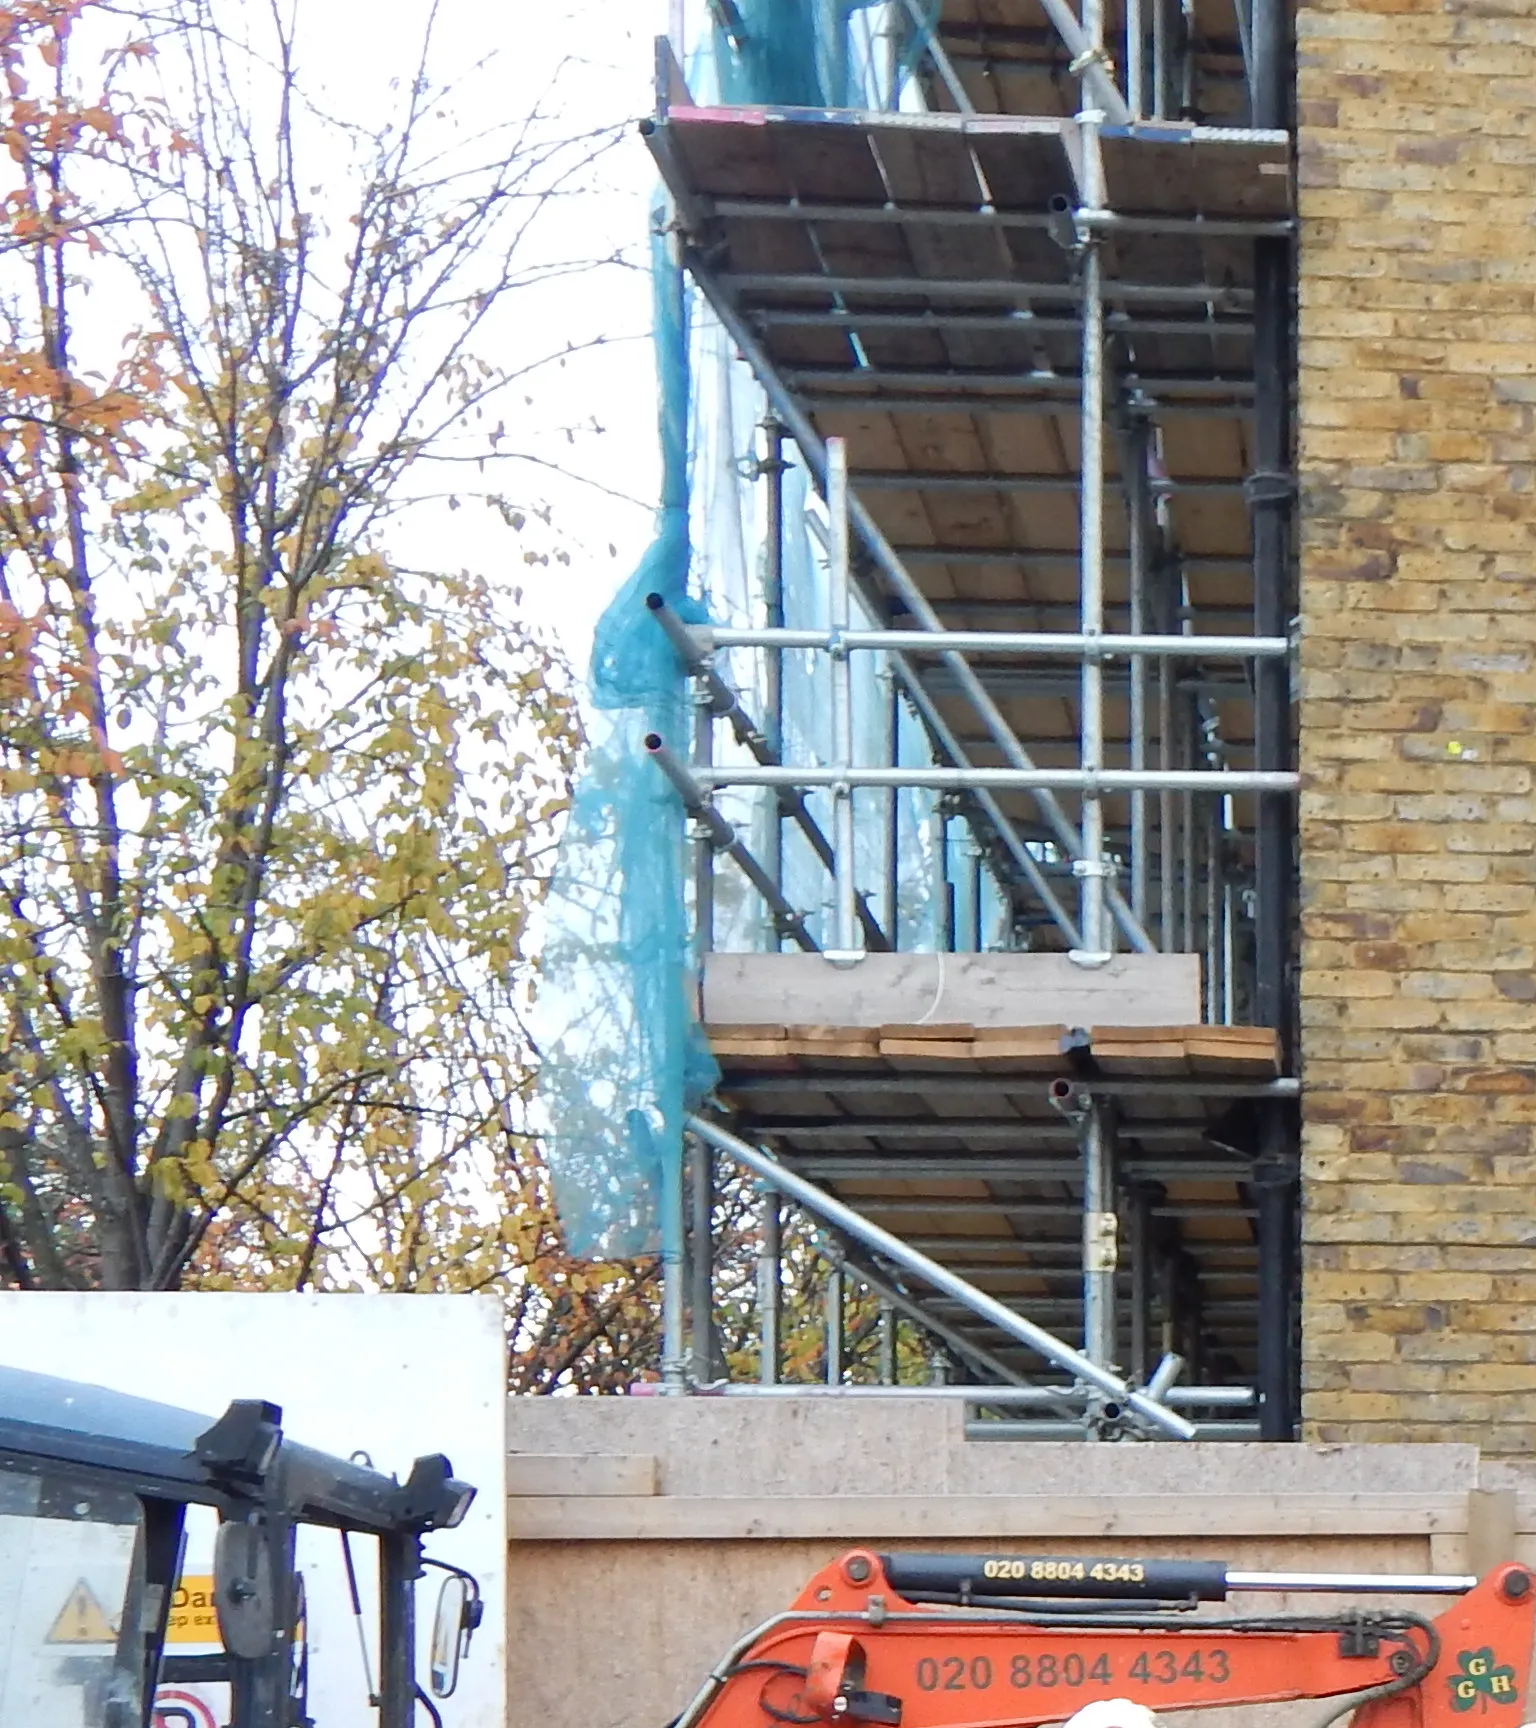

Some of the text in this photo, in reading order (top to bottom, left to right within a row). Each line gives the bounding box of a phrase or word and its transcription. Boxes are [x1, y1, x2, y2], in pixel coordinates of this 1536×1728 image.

[984, 1559, 1145, 1582] 020 8804 4343
[916, 1648, 1231, 1692] 020 8804 4343
